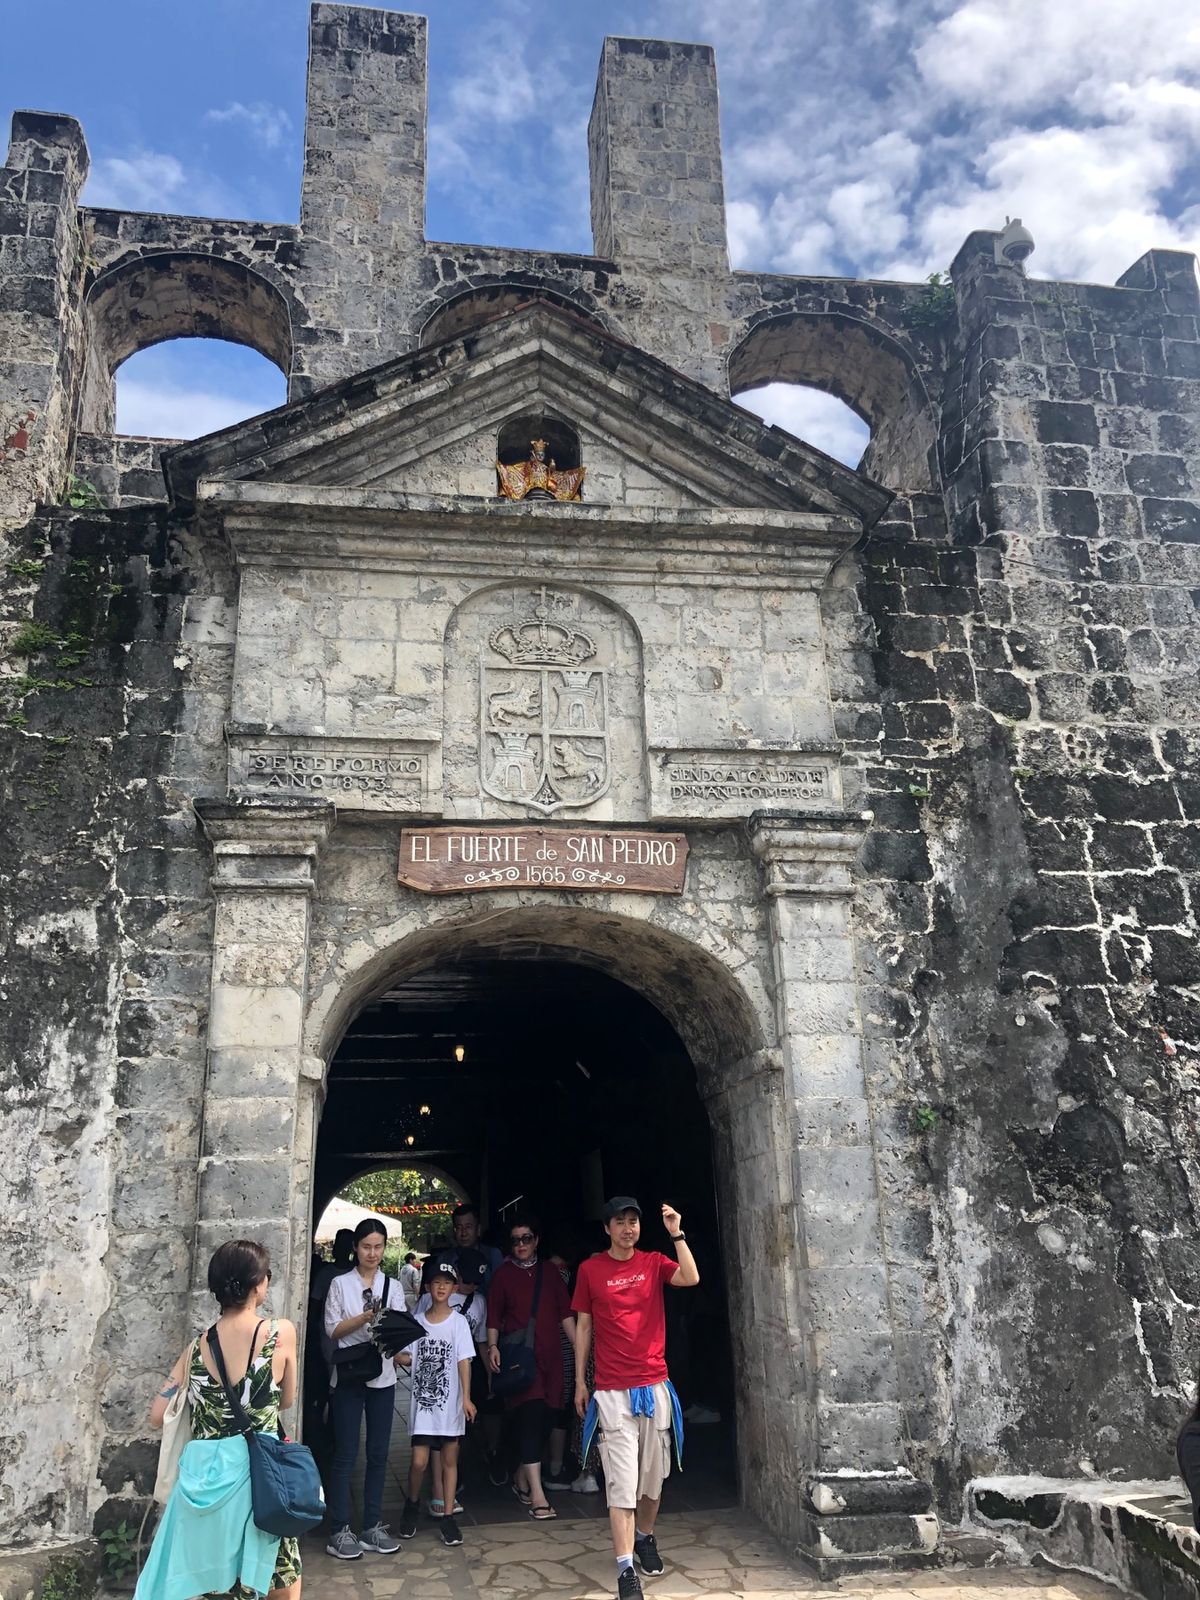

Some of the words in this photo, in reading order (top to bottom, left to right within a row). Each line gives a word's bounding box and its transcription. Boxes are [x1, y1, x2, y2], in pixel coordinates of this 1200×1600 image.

[411, 836, 439, 862] EL
[447, 836, 527, 863] FUERTE
[536, 847, 558, 862] de
[566, 836, 603, 863] SAN
[612, 838, 676, 866] PEDRO
[526, 865, 566, 883] 1565
